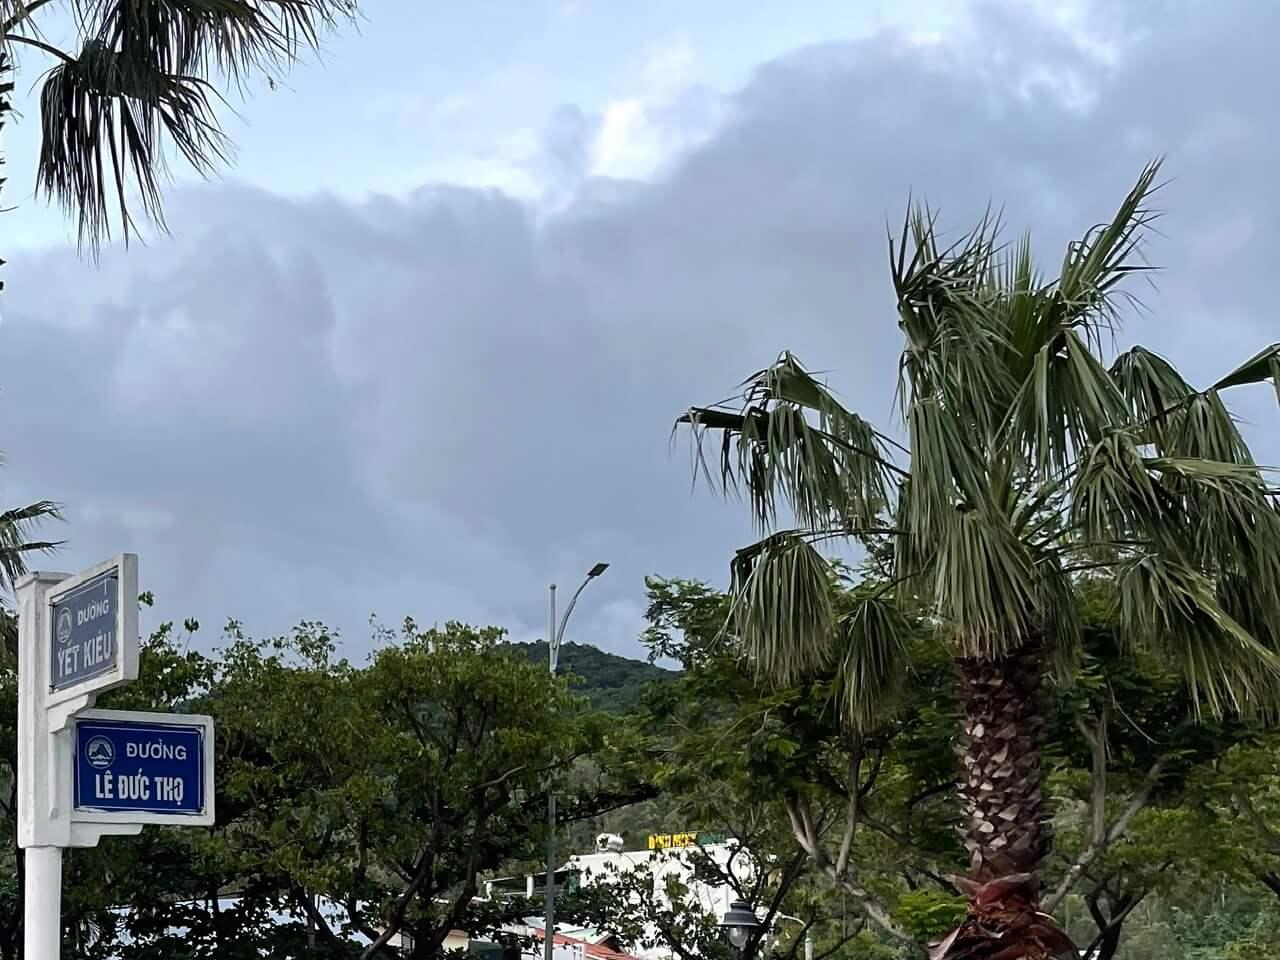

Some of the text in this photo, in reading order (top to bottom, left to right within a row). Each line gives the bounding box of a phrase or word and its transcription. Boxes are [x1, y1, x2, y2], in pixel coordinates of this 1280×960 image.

[58, 629, 111, 677] YẾT KIÊU
[126, 738, 187, 760] ĐƯỜNG
[95, 768, 184, 806] LÊ ĐỨC THỌ
